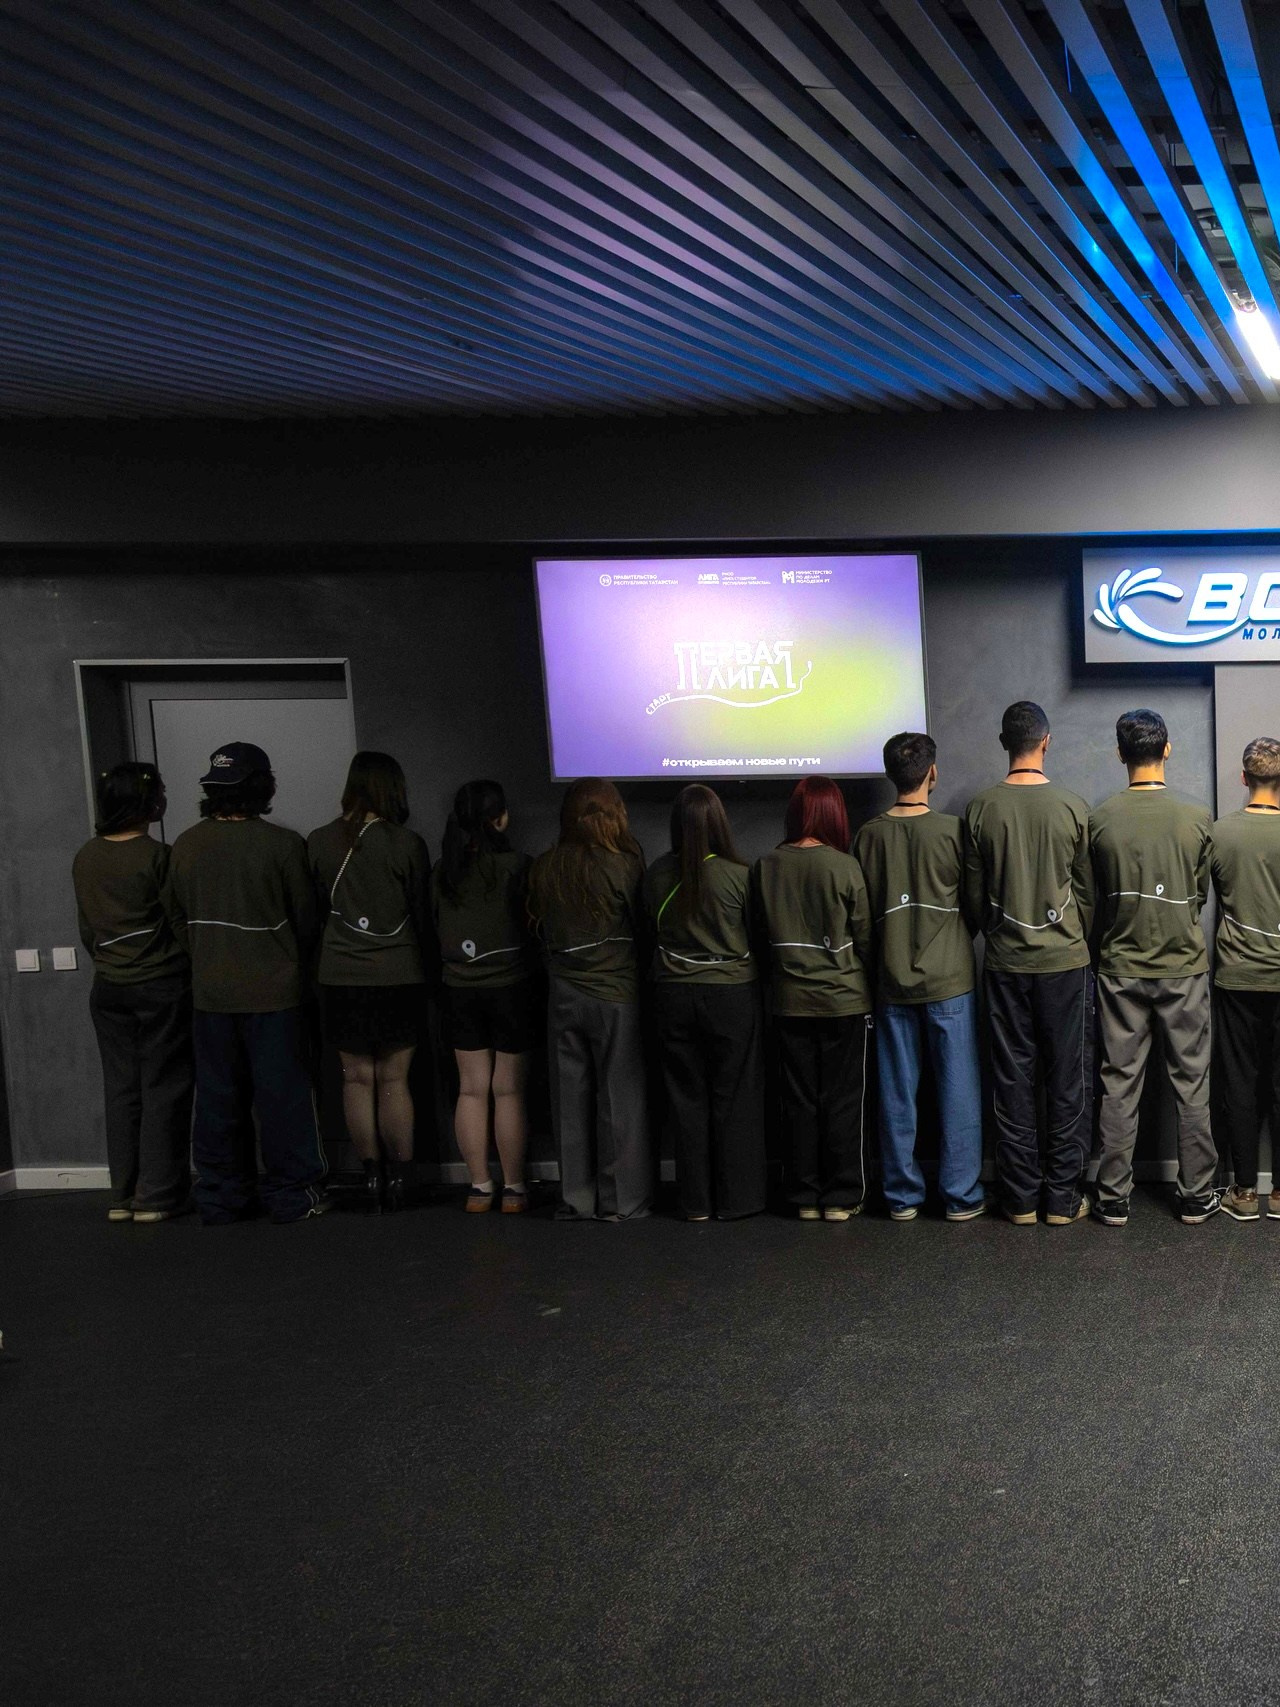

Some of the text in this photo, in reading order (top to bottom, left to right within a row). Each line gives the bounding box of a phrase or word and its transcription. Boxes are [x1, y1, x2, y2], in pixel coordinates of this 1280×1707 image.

[706, 665, 780, 690] ЛИГА
[645, 693, 672, 715] СТАРТ
[662, 757, 821, 768] #открываем новые пути
